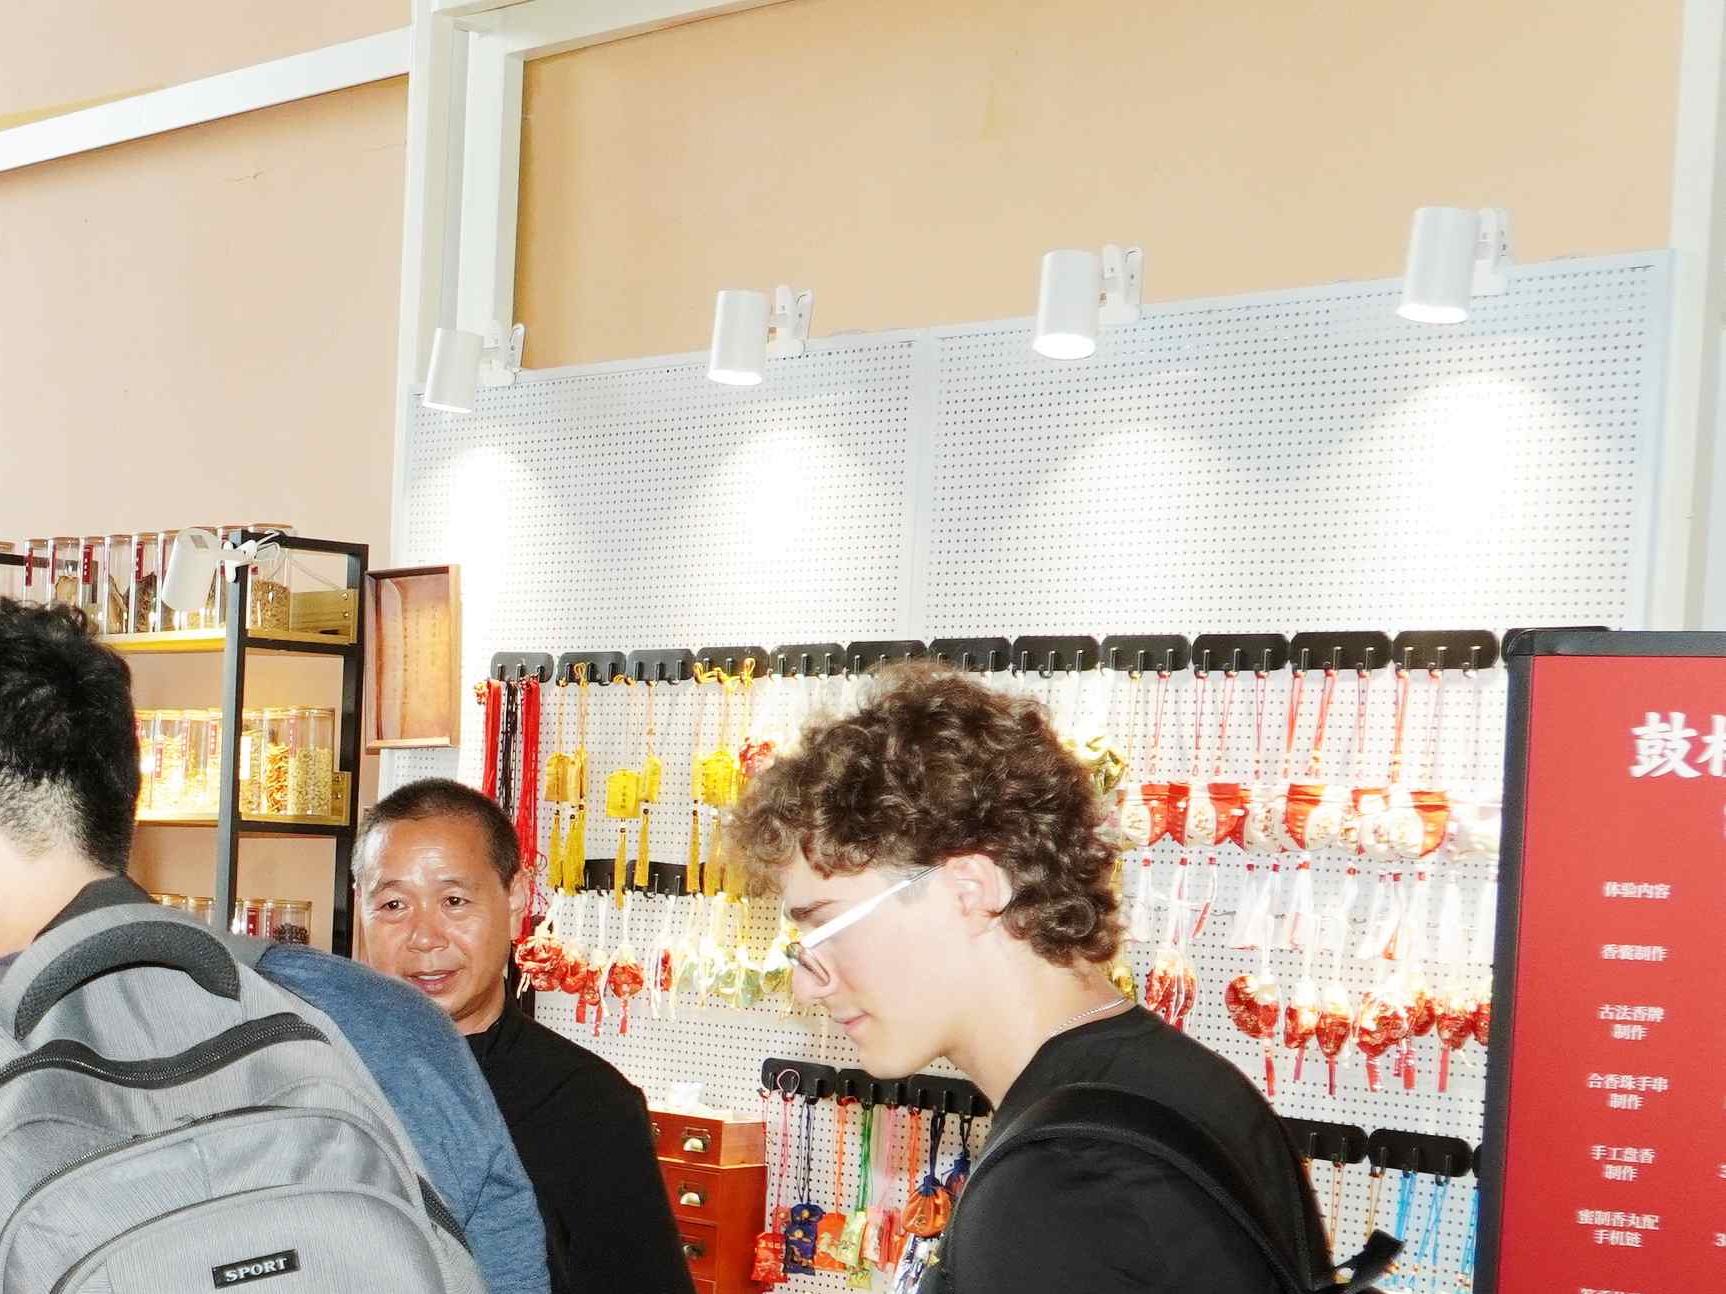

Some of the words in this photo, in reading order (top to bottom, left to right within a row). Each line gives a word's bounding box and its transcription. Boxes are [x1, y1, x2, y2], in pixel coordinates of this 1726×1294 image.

[1603, 881, 1671, 899] 体验内容
[1599, 1004, 1664, 1022] 古法香牌
[1612, 1025, 1647, 1040] 制作
[1587, 1073, 1668, 1092] 合香珠手串
[1609, 1093, 1643, 1109] 制作
[1590, 1145, 1655, 1163] 手工盘香
[1603, 1165, 1638, 1181] 制作
[225, 1257, 287, 1282] SPORT
